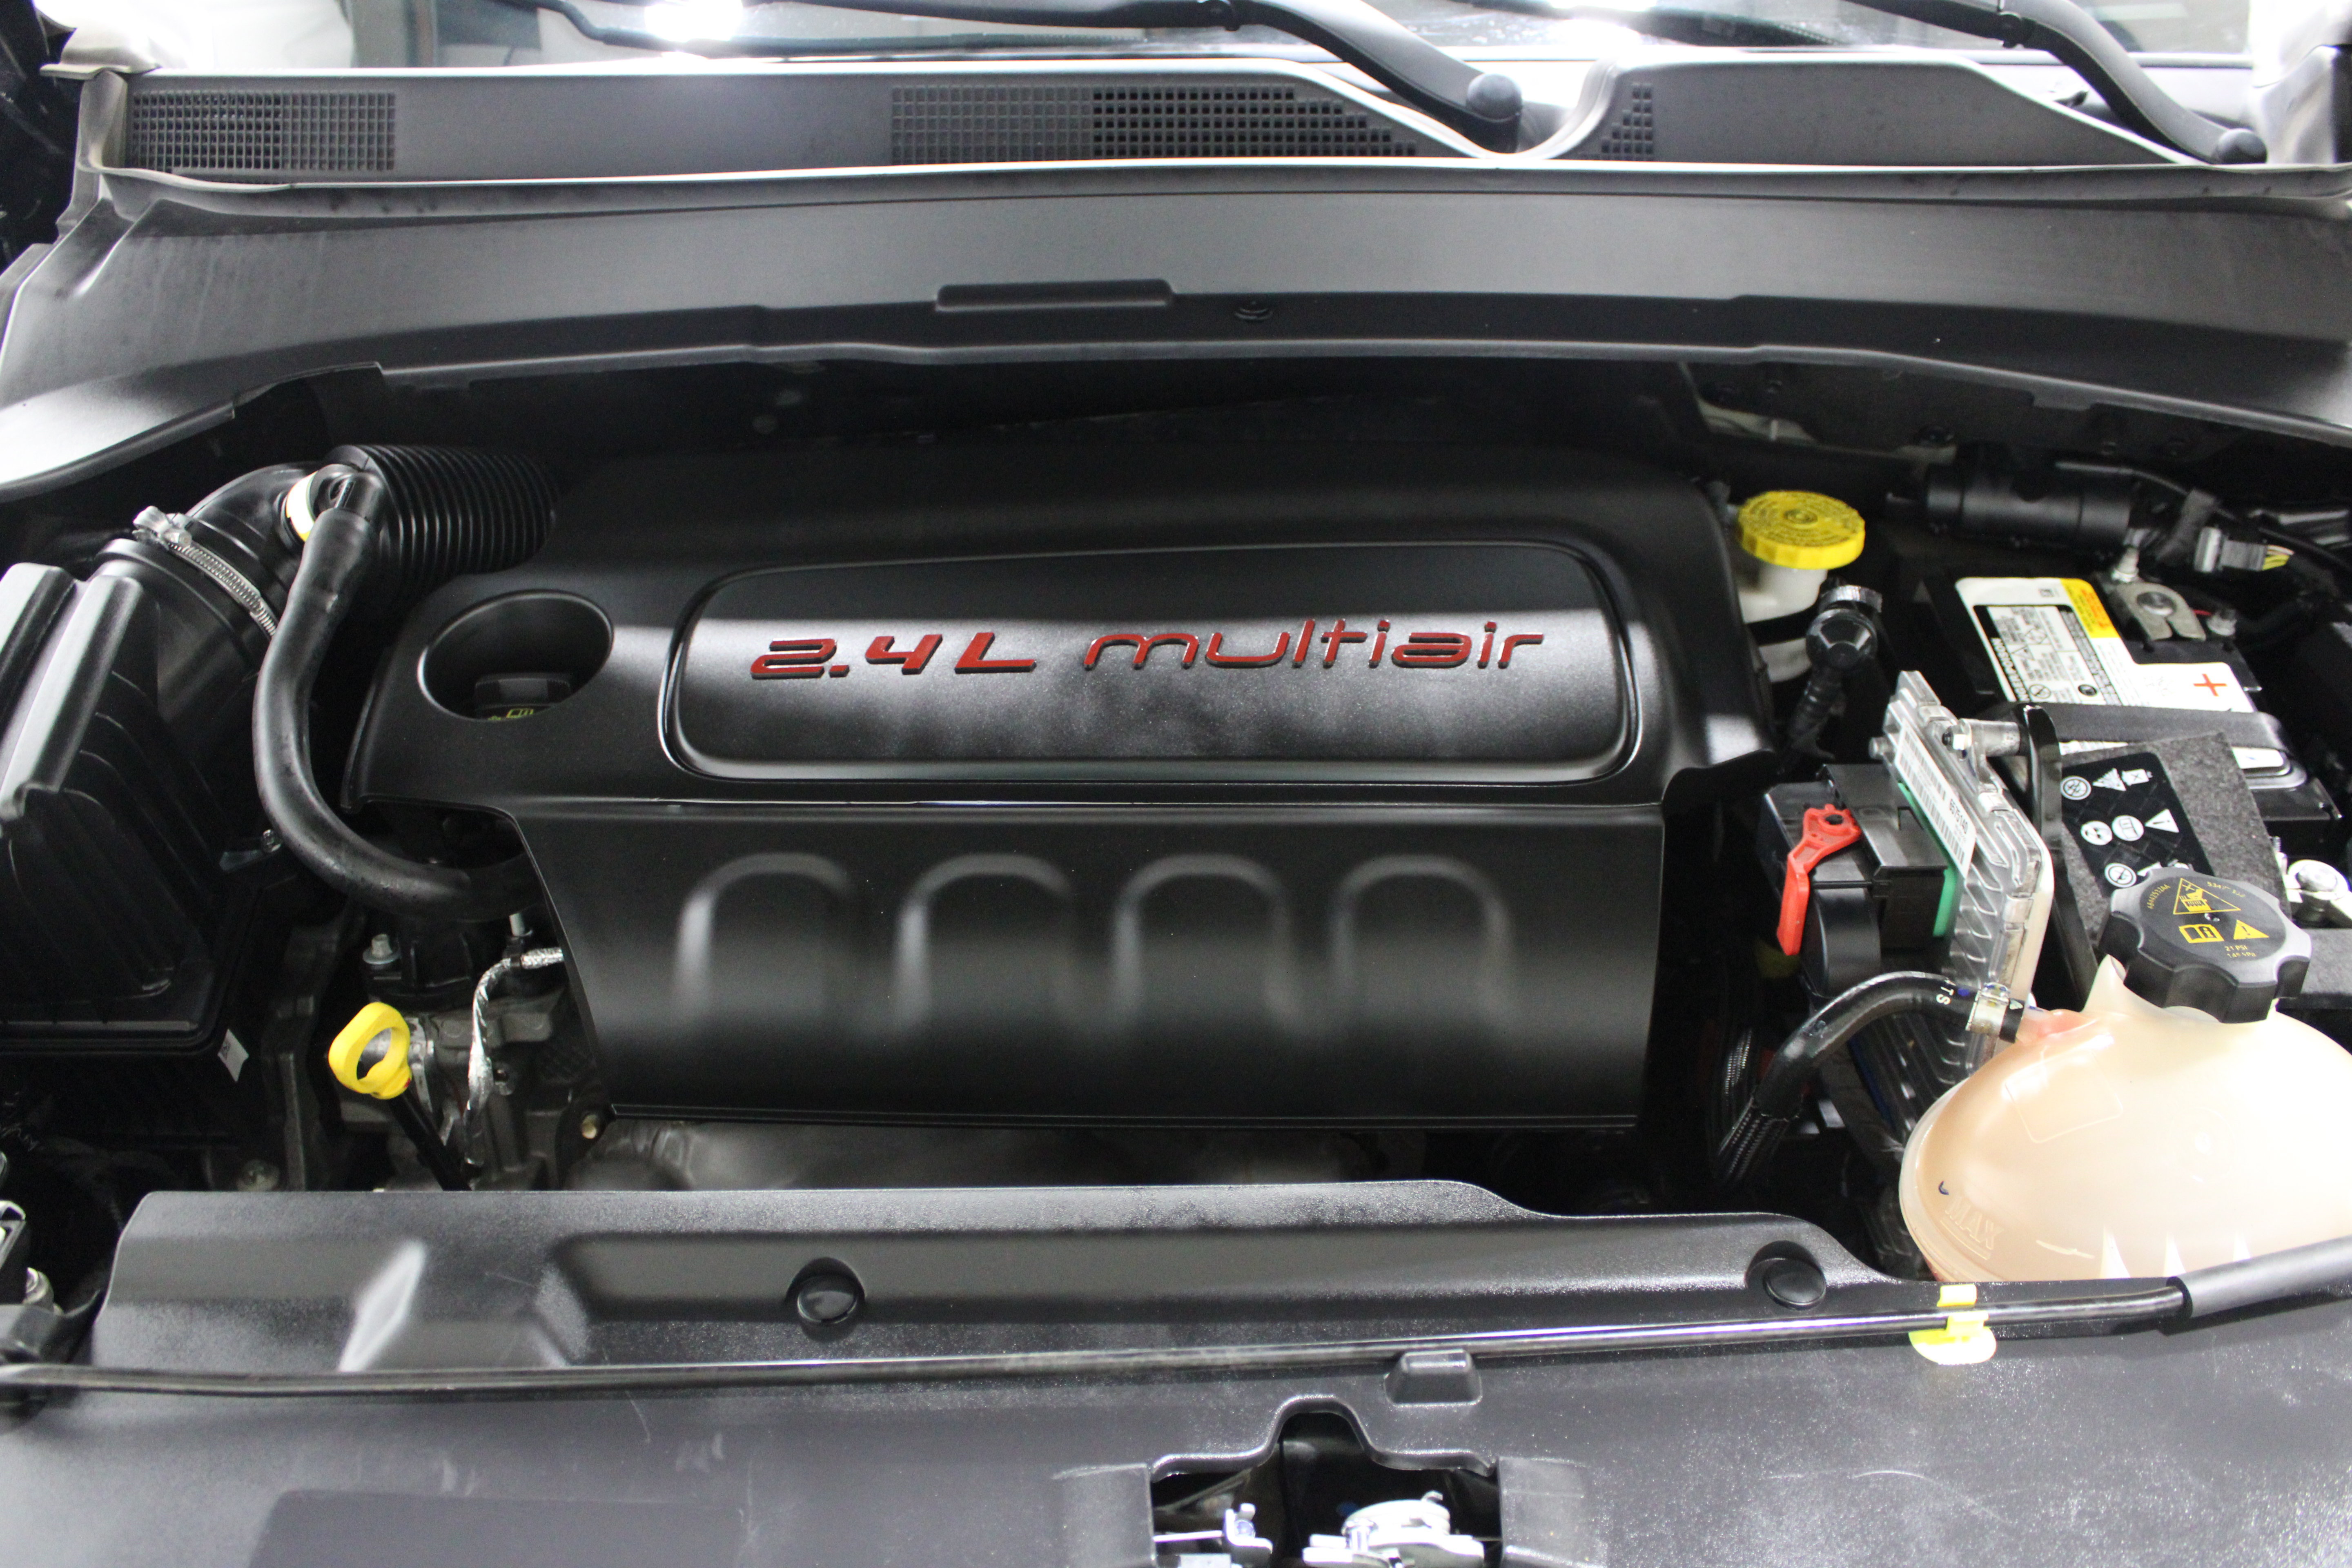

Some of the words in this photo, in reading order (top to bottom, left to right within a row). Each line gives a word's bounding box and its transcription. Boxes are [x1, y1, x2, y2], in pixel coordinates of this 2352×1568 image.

[751, 630, 1036, 678] 2.4L
[1083, 618, 1544, 670] multiair
[1944, 1198, 2004, 1250] MAX
